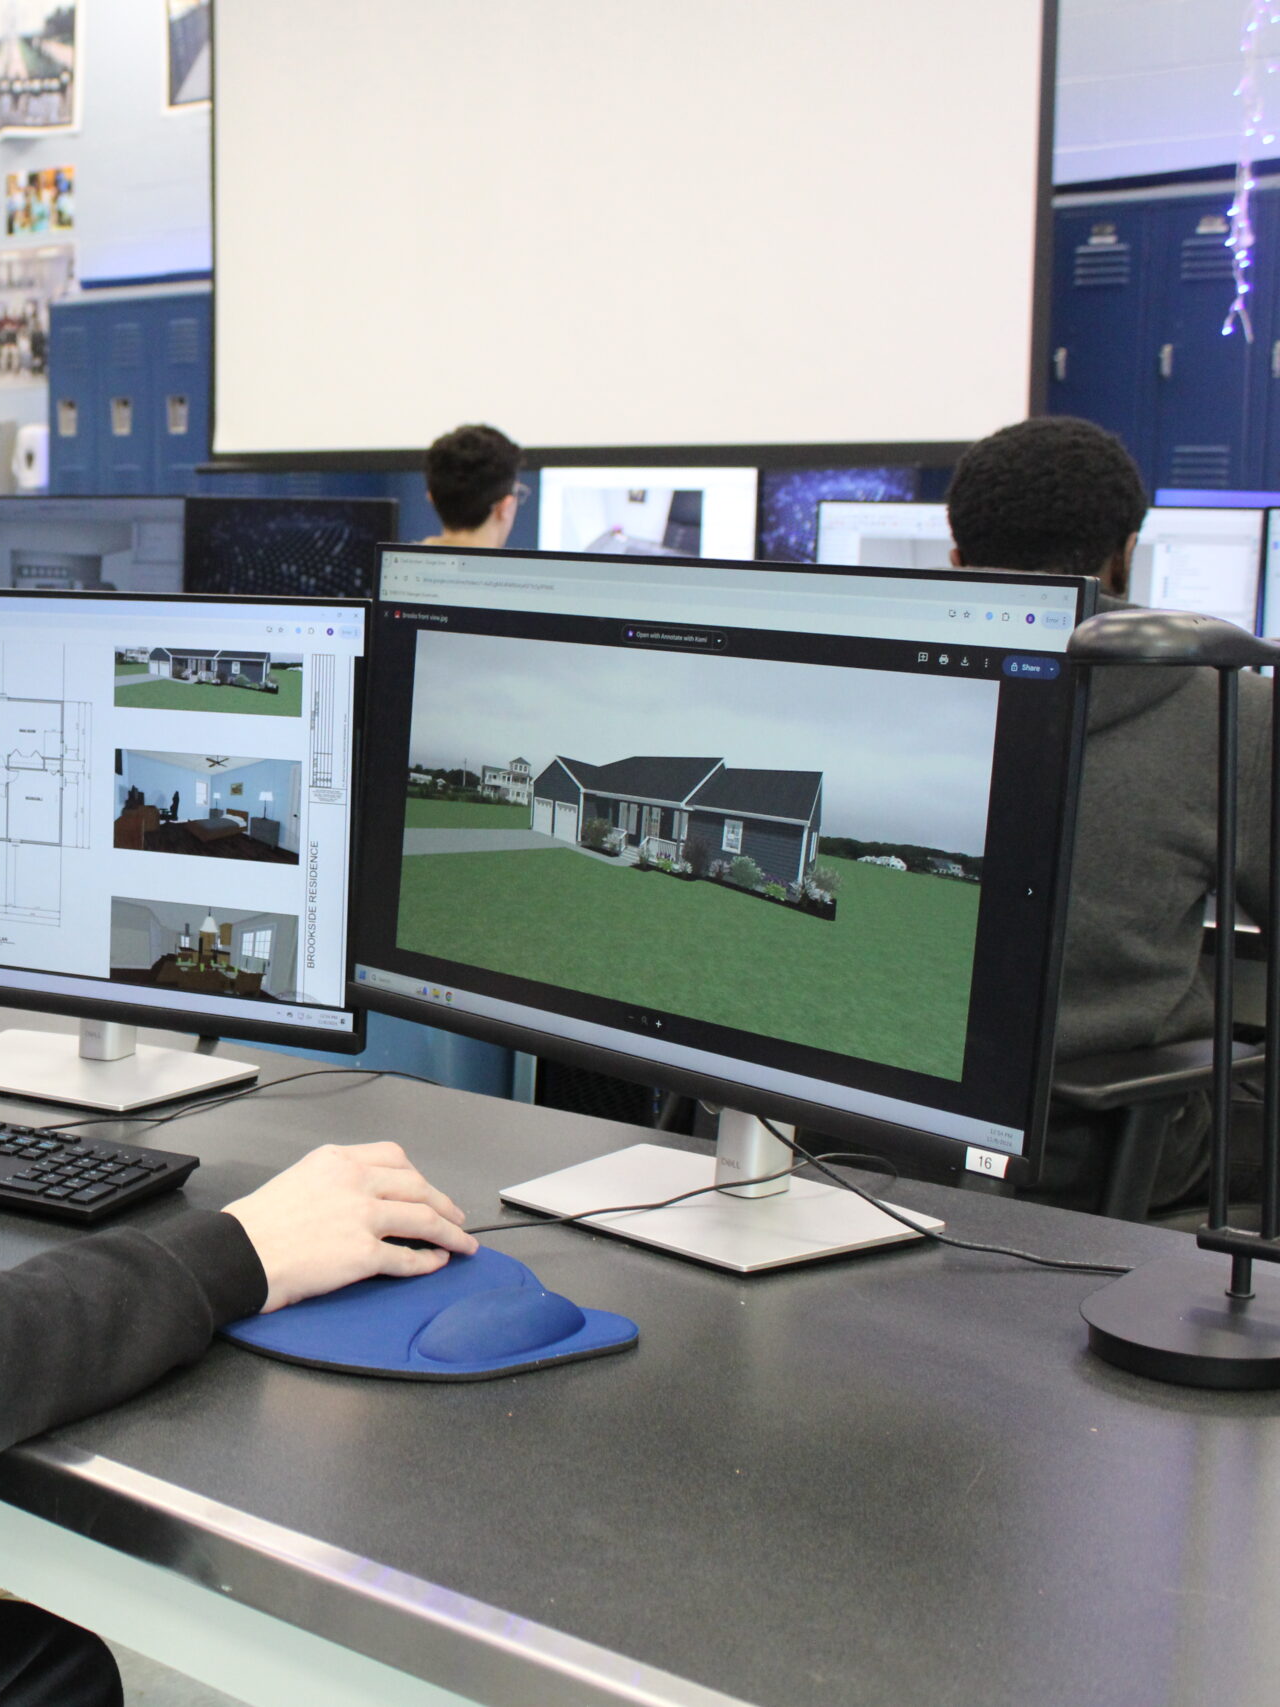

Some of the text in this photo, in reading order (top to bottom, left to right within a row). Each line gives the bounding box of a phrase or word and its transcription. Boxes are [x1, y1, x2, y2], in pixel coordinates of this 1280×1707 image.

[636, 631, 650, 639] Open
[650, 631, 661, 639] with
[661, 633, 683, 641] Annotate
[1022, 664, 1040, 672] Share
[306, 840, 319, 969] BROOKSIDE RESIDENCE
[978, 1156, 992, 1170] 16
